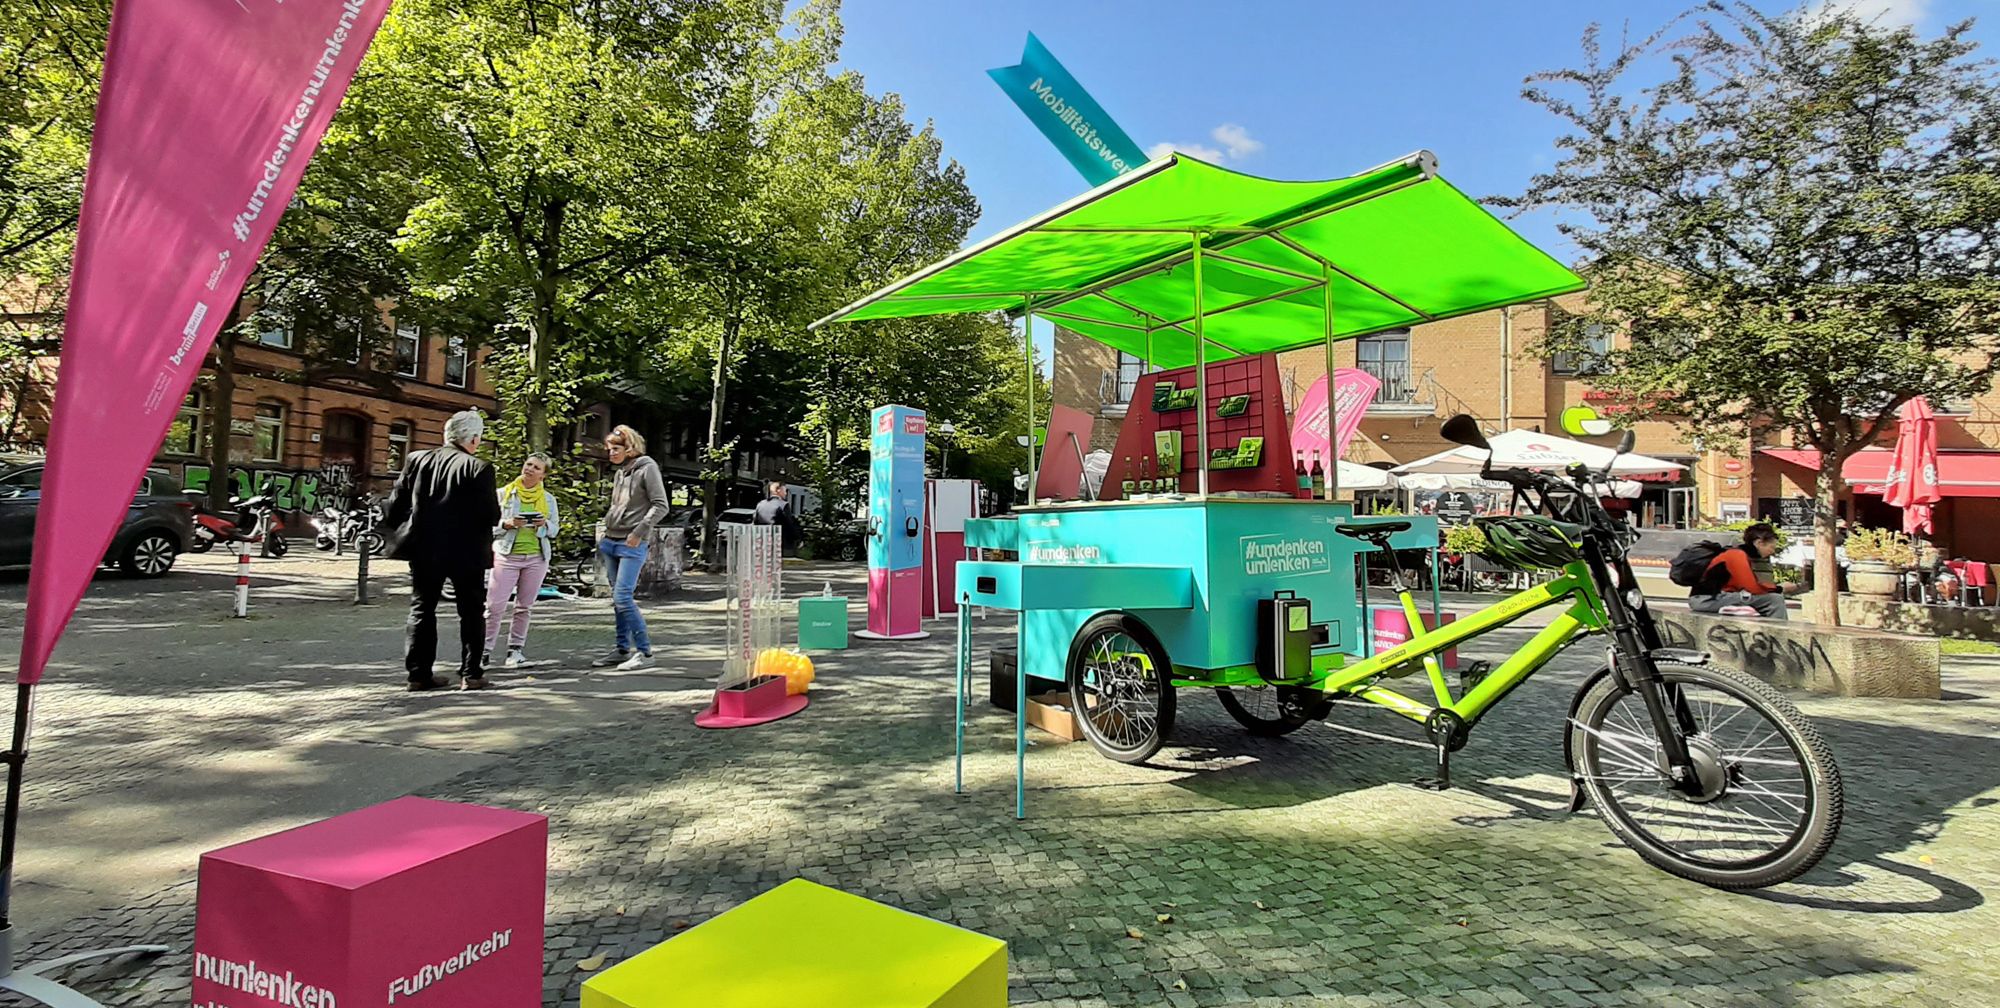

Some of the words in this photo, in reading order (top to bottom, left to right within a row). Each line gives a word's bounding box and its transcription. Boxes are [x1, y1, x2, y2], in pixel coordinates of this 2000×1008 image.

[1030, 544, 1099, 561] #umdenken
[1246, 538, 1323, 559] #umdenken
[1246, 555, 1310, 575] umlenken
[388, 926, 513, 1005] Fußverkehr
[195, 951, 336, 1008] numlenken
